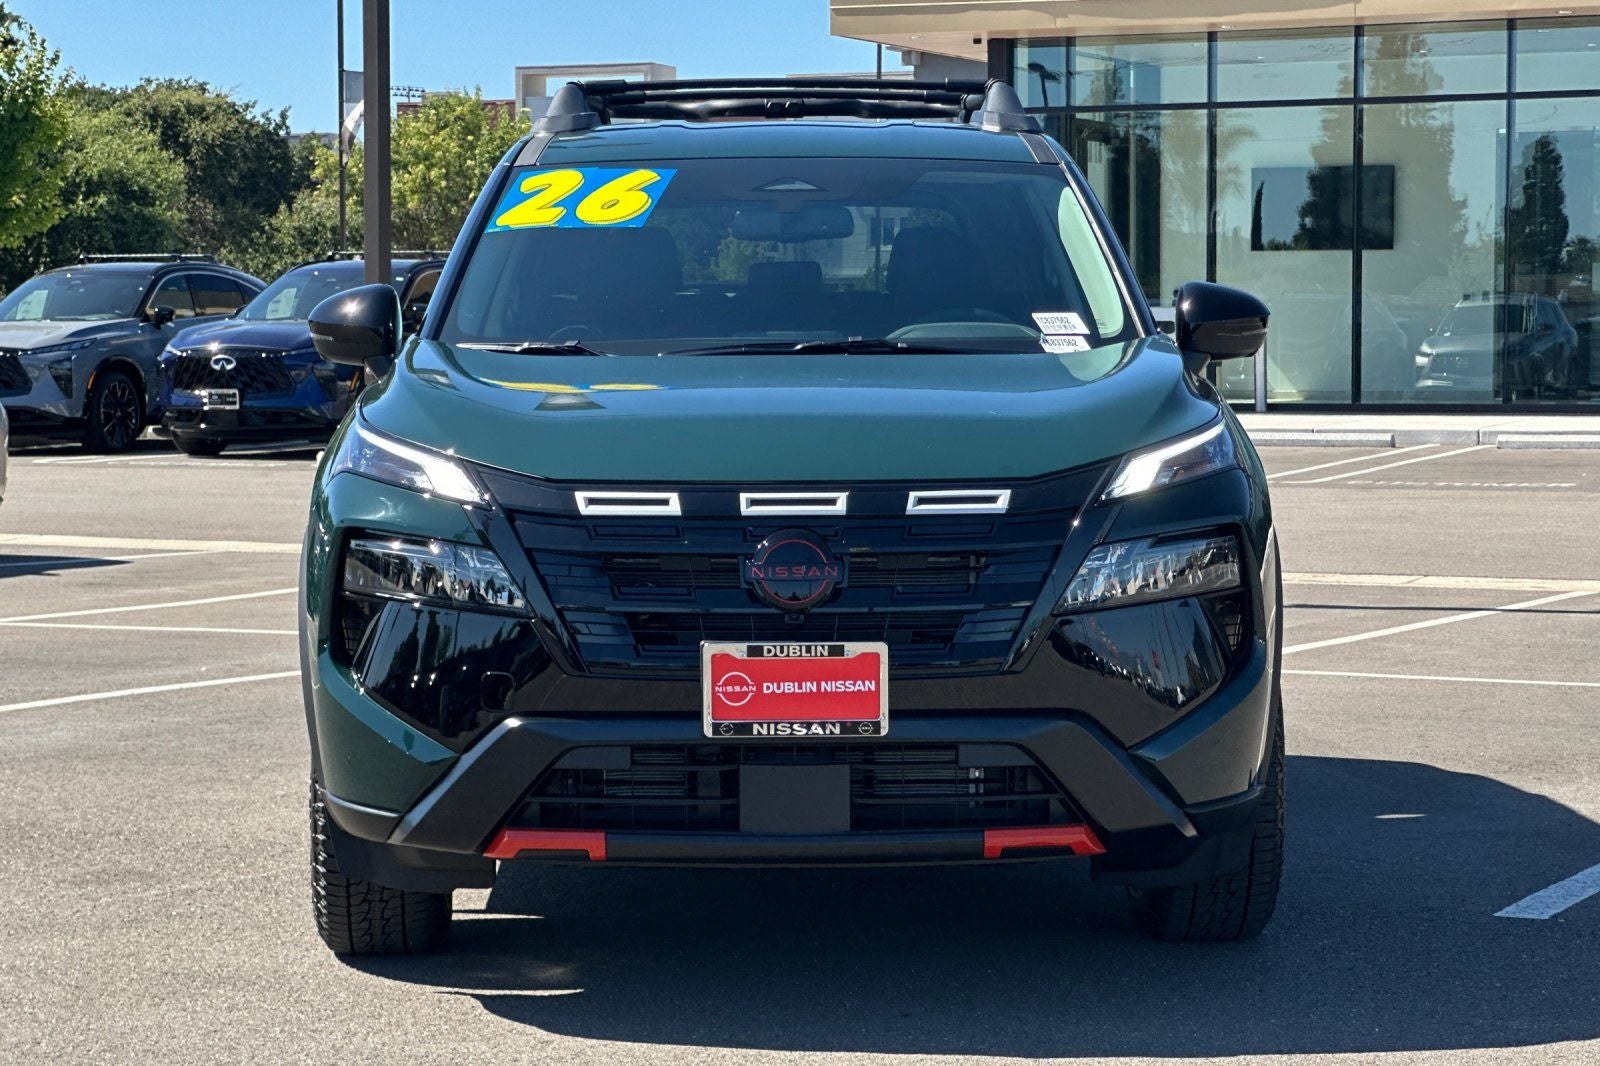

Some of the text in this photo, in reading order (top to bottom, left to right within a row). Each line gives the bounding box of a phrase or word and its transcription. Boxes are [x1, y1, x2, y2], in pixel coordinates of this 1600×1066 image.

[496, 169, 661, 227] 26
[751, 566, 838, 577] NISSAN
[763, 645, 828, 657] DUBLIN
[763, 680, 876, 694] DUBLIN NISSAN
[752, 723, 841, 735] NISSAN
